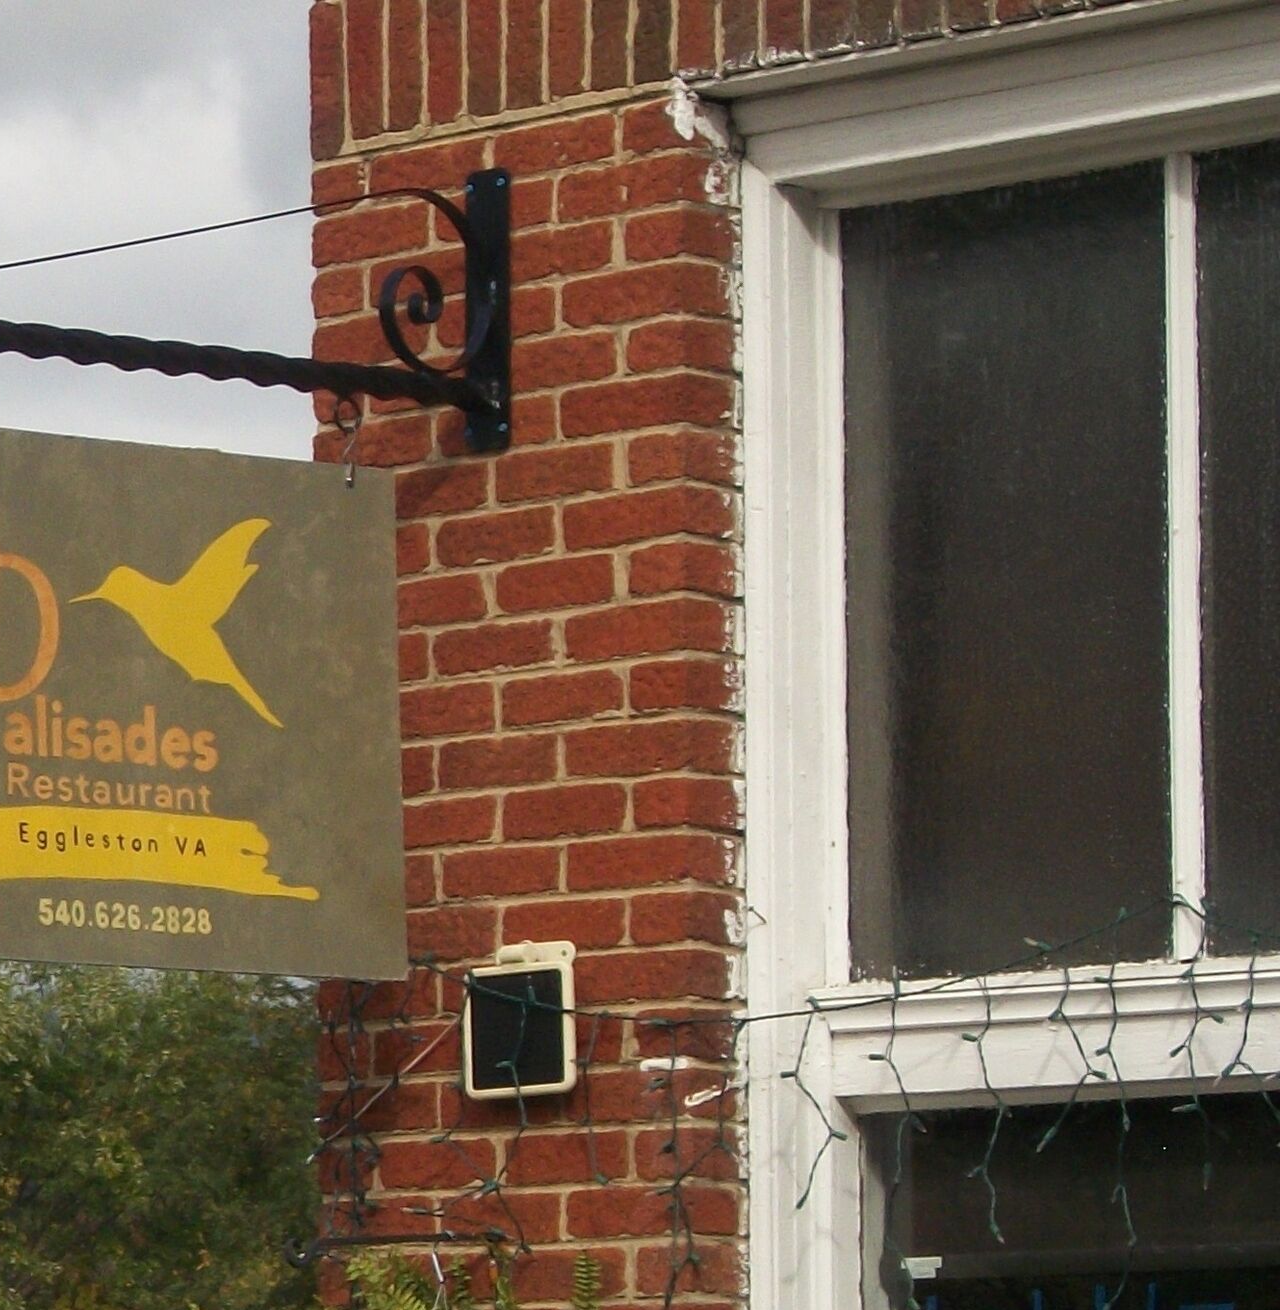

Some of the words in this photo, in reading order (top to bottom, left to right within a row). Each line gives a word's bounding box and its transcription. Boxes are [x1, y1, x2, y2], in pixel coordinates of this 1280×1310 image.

[6, 762, 212, 813] Restaurant
[18, 821, 159, 852] Eggleston
[175, 835, 207, 857] VA
[38, 897, 213, 935] 540.626.2828
